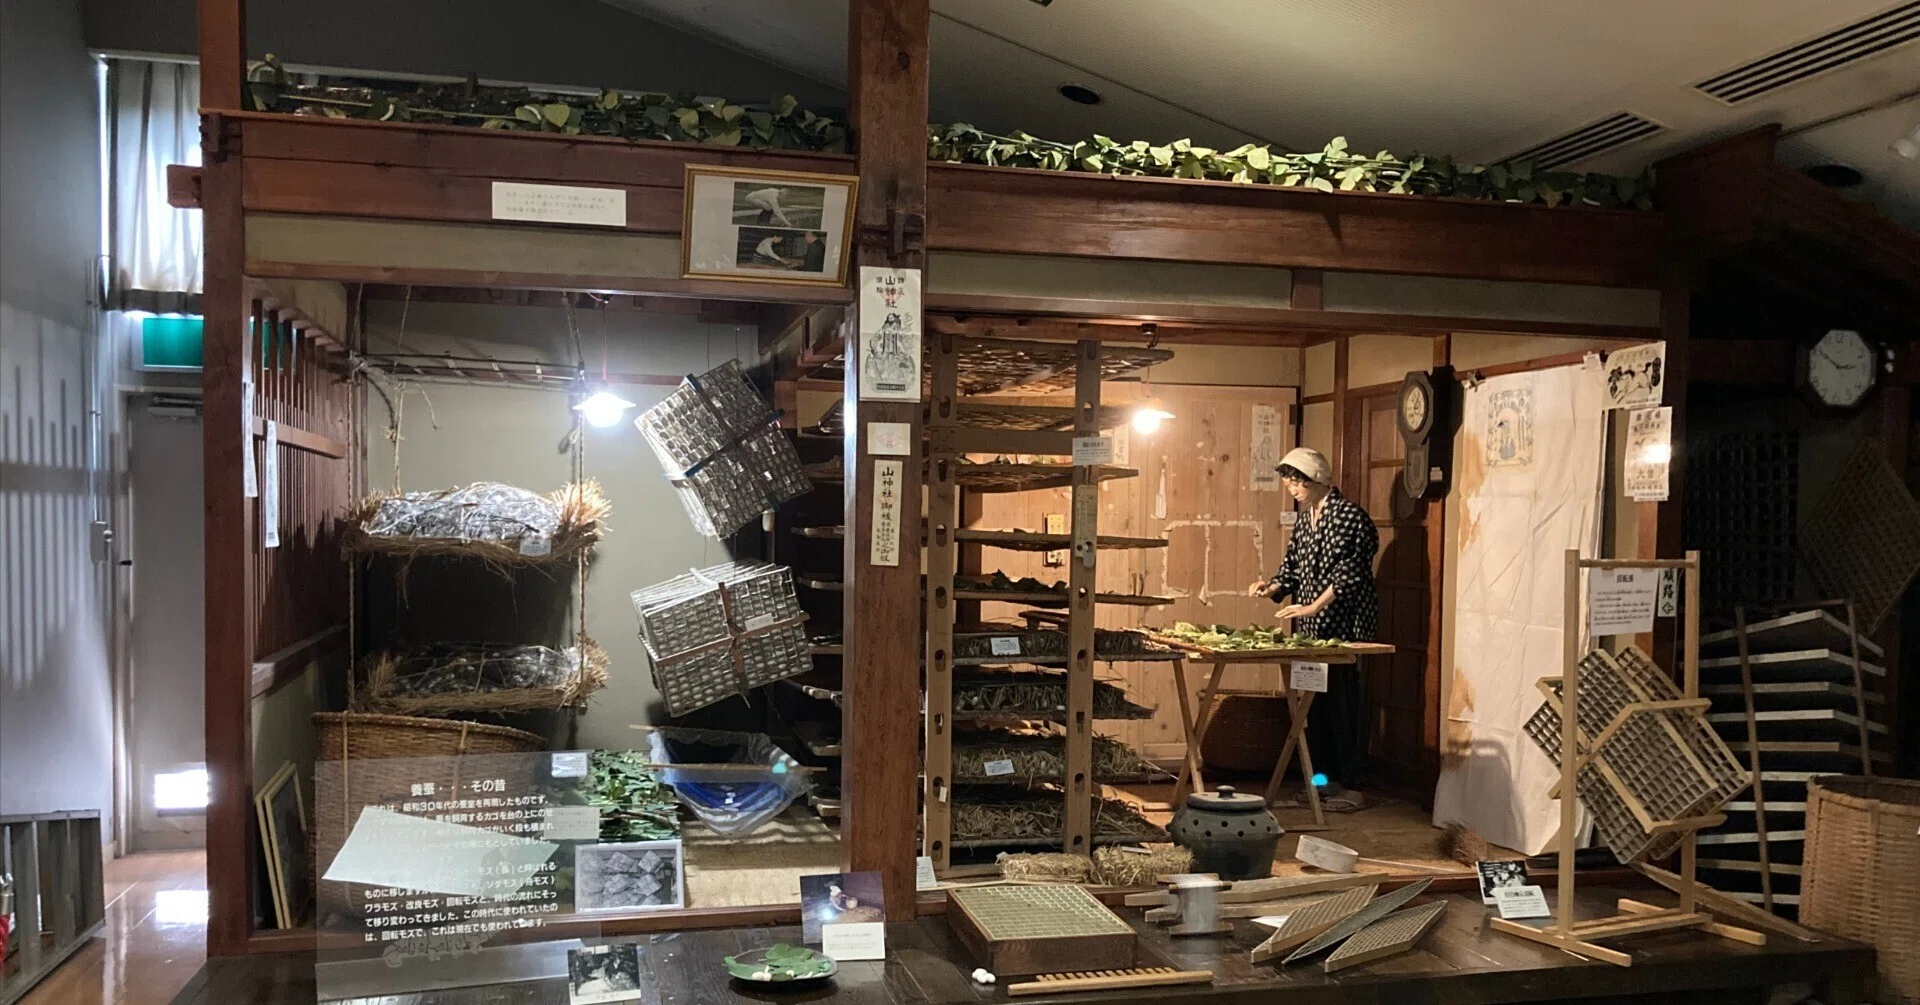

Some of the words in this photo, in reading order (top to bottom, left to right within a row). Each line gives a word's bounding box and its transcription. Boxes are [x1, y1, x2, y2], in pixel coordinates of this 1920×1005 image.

[364, 918, 547, 943] は、回転モズで、これは現在でも使われてます。
